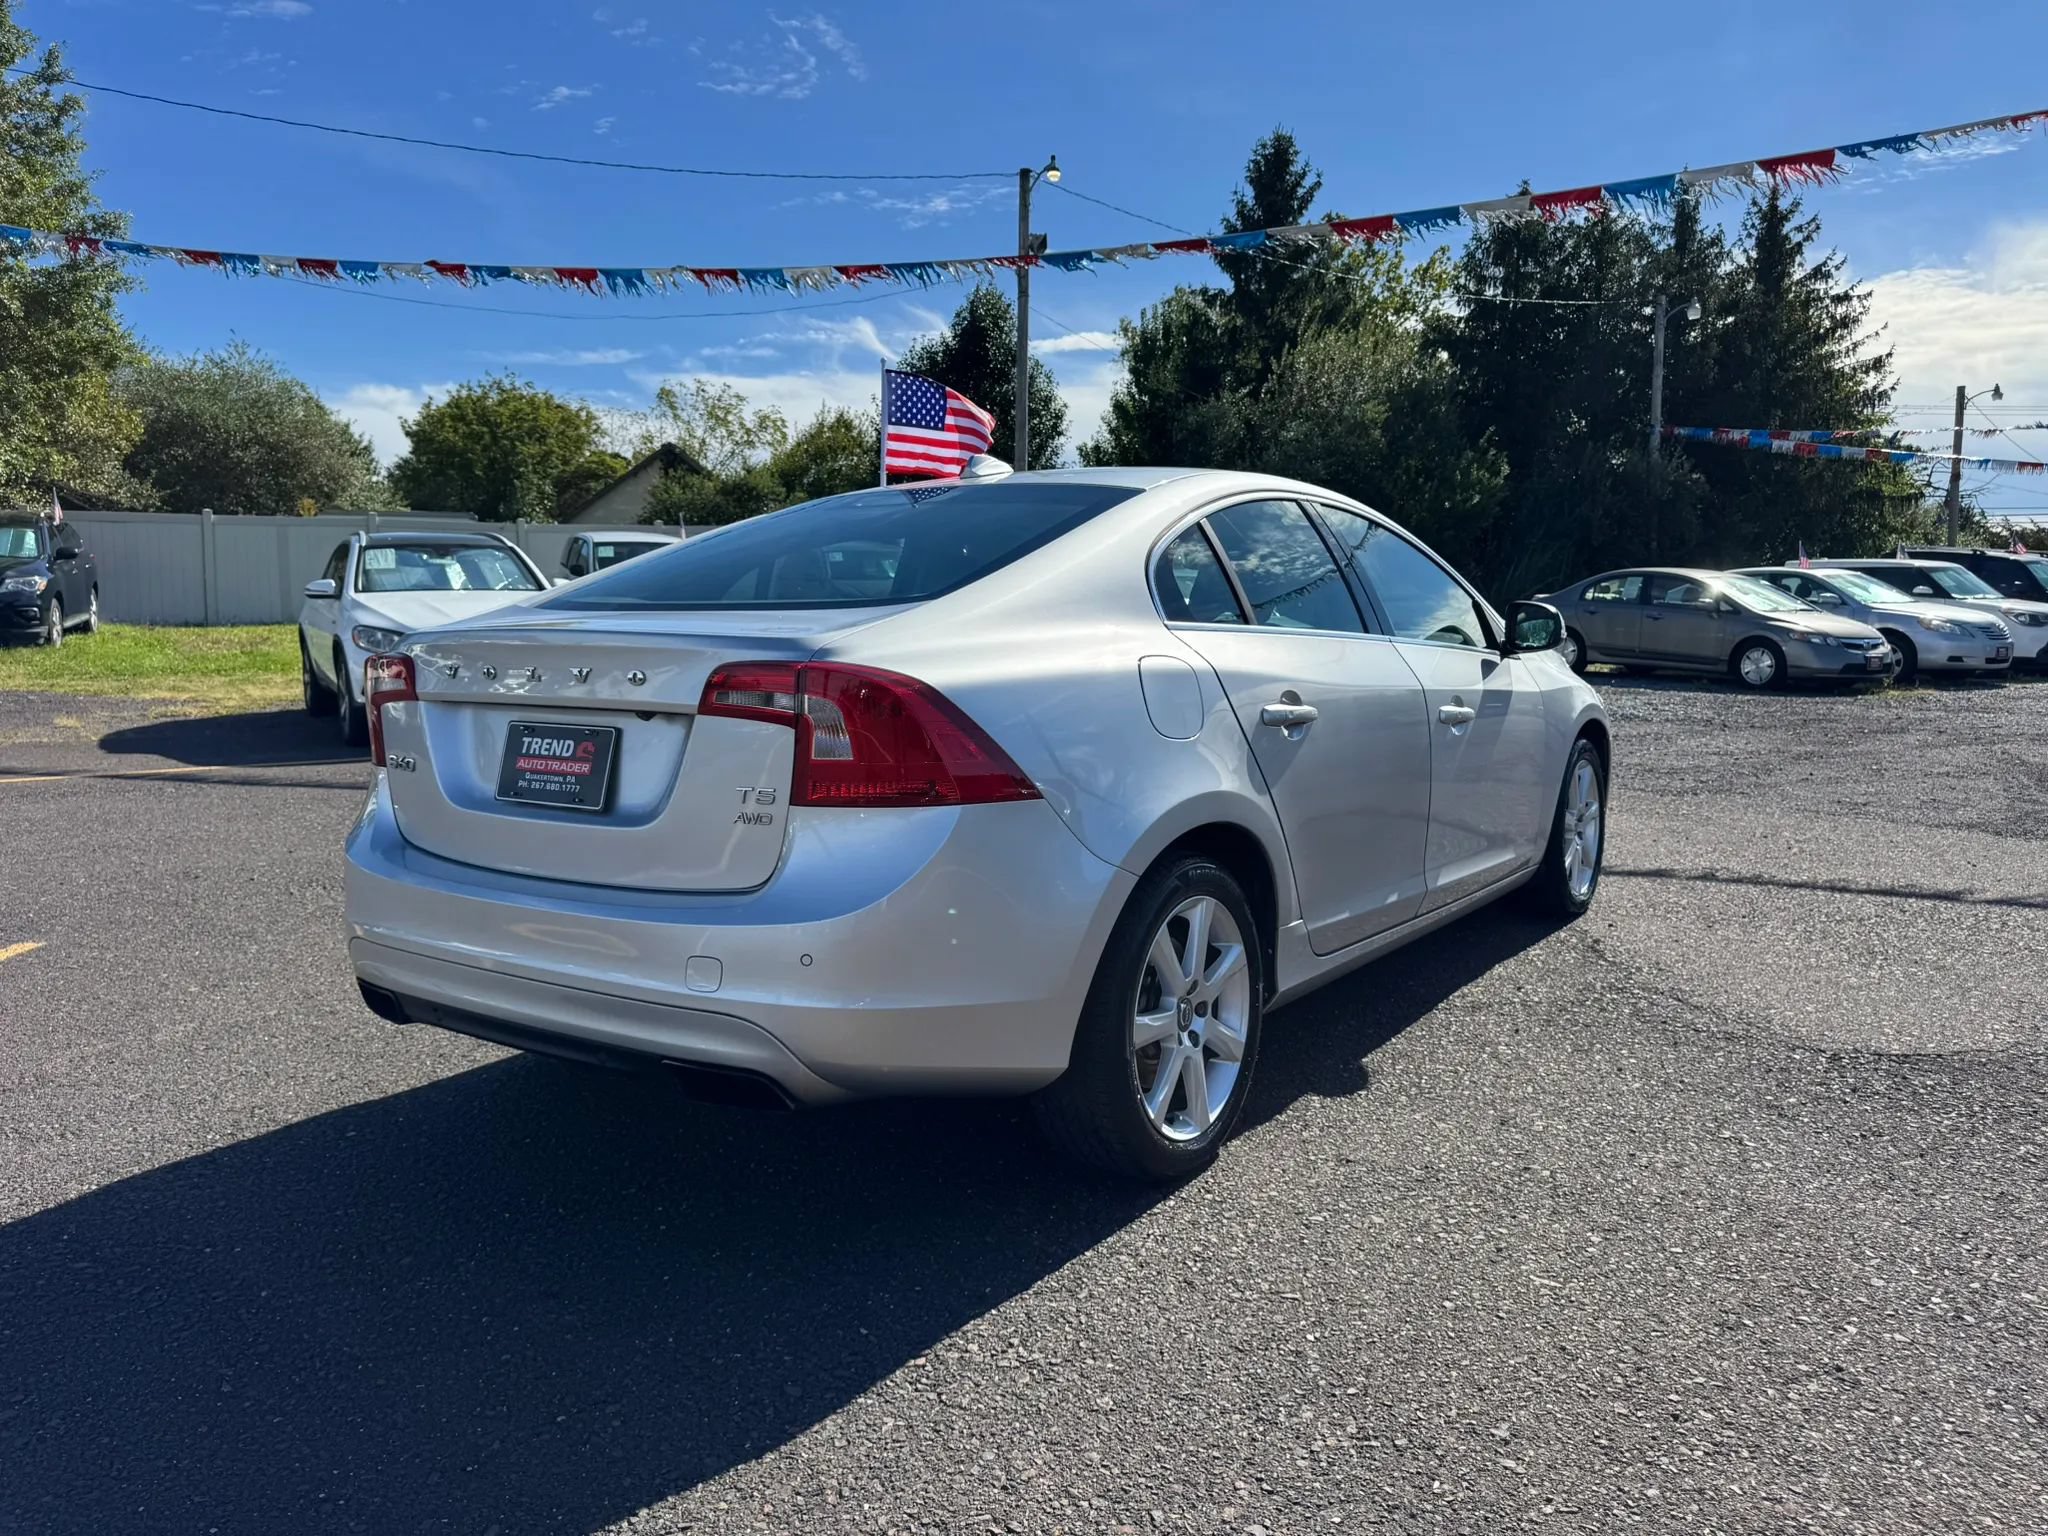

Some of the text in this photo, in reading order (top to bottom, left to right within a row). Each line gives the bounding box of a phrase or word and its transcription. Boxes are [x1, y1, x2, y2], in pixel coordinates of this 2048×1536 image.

[445, 663, 647, 687] VOLVO
[521, 737, 575, 757] TREND
[389, 754, 417, 773] S60
[517, 759, 590, 773] AUTO TRADER
[566, 775, 576, 783] PA
[735, 786, 776, 805] T5
[733, 811, 773, 826] AWD
